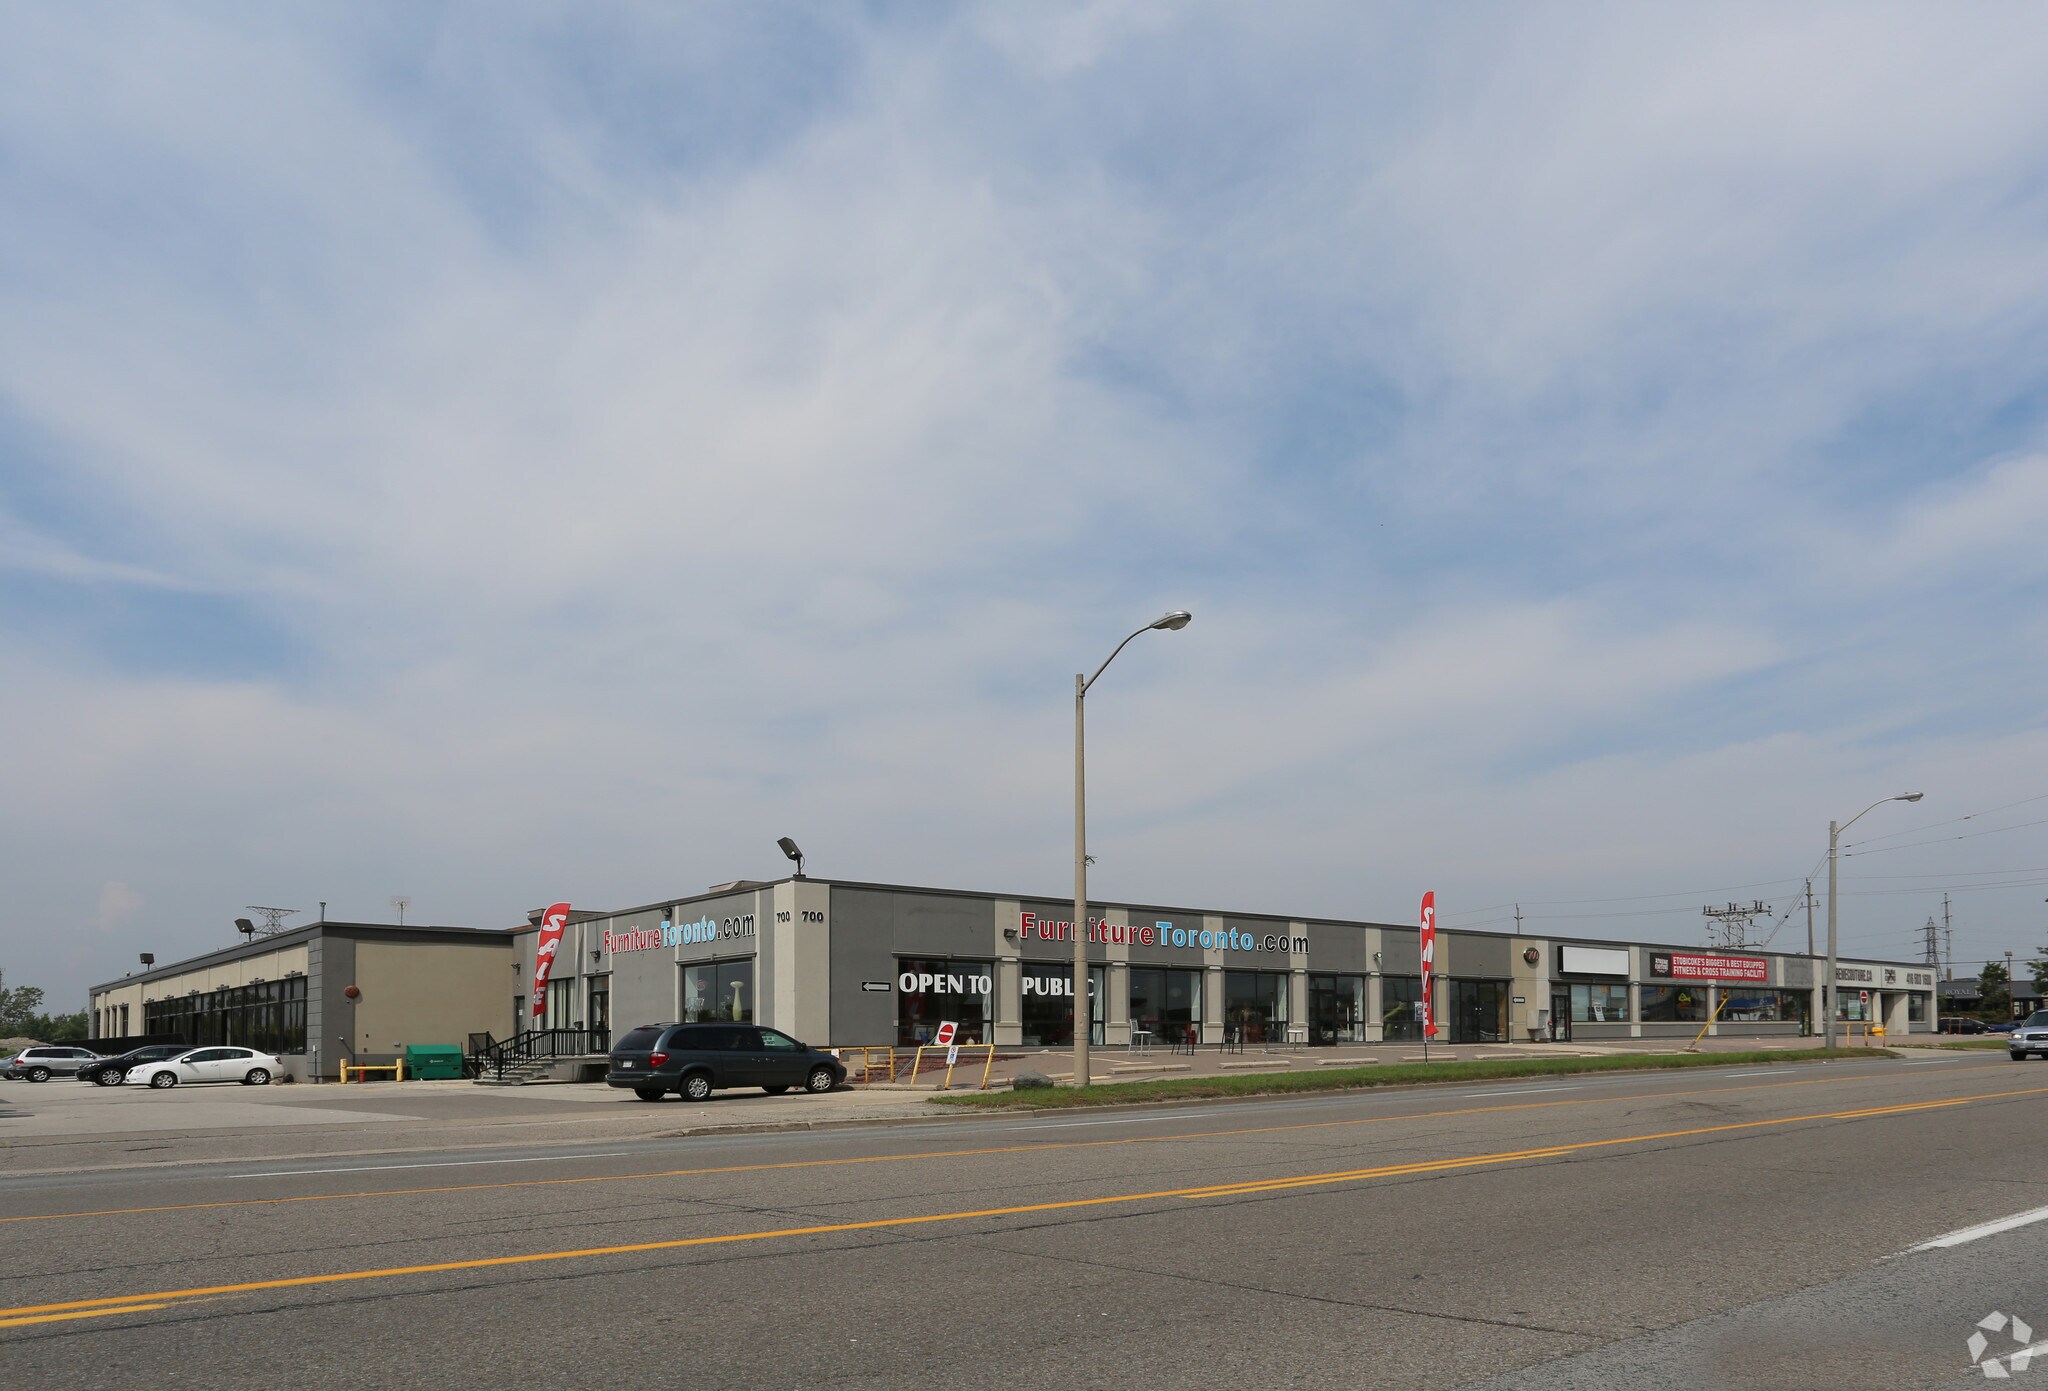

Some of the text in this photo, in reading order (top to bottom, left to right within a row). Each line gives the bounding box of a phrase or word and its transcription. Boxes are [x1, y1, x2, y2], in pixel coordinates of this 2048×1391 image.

[776, 910, 791, 923] 700
[801, 911, 824, 923] 700
[604, 914, 755, 954] FurnitureToronto.com
[1020, 912, 1309, 953] FuritureToronto.com
[533, 914, 567, 1005] SALE
[1673, 957, 1705, 966] ETOBICOKE'S
[1706, 958, 1726, 968] BIGGEST
[1731, 960, 1743, 969] BEST
[1744, 961, 1765, 969] EQUIPPED
[1673, 966, 1697, 976] FITNESS
[1702, 967, 1719, 977] CROSS
[1719, 968, 1744, 978] TRAINING
[1744, 969, 1765, 979] FACILITY
[900, 973, 992, 995] OPEN TO
[1022, 976, 1094, 997] PUBLC
